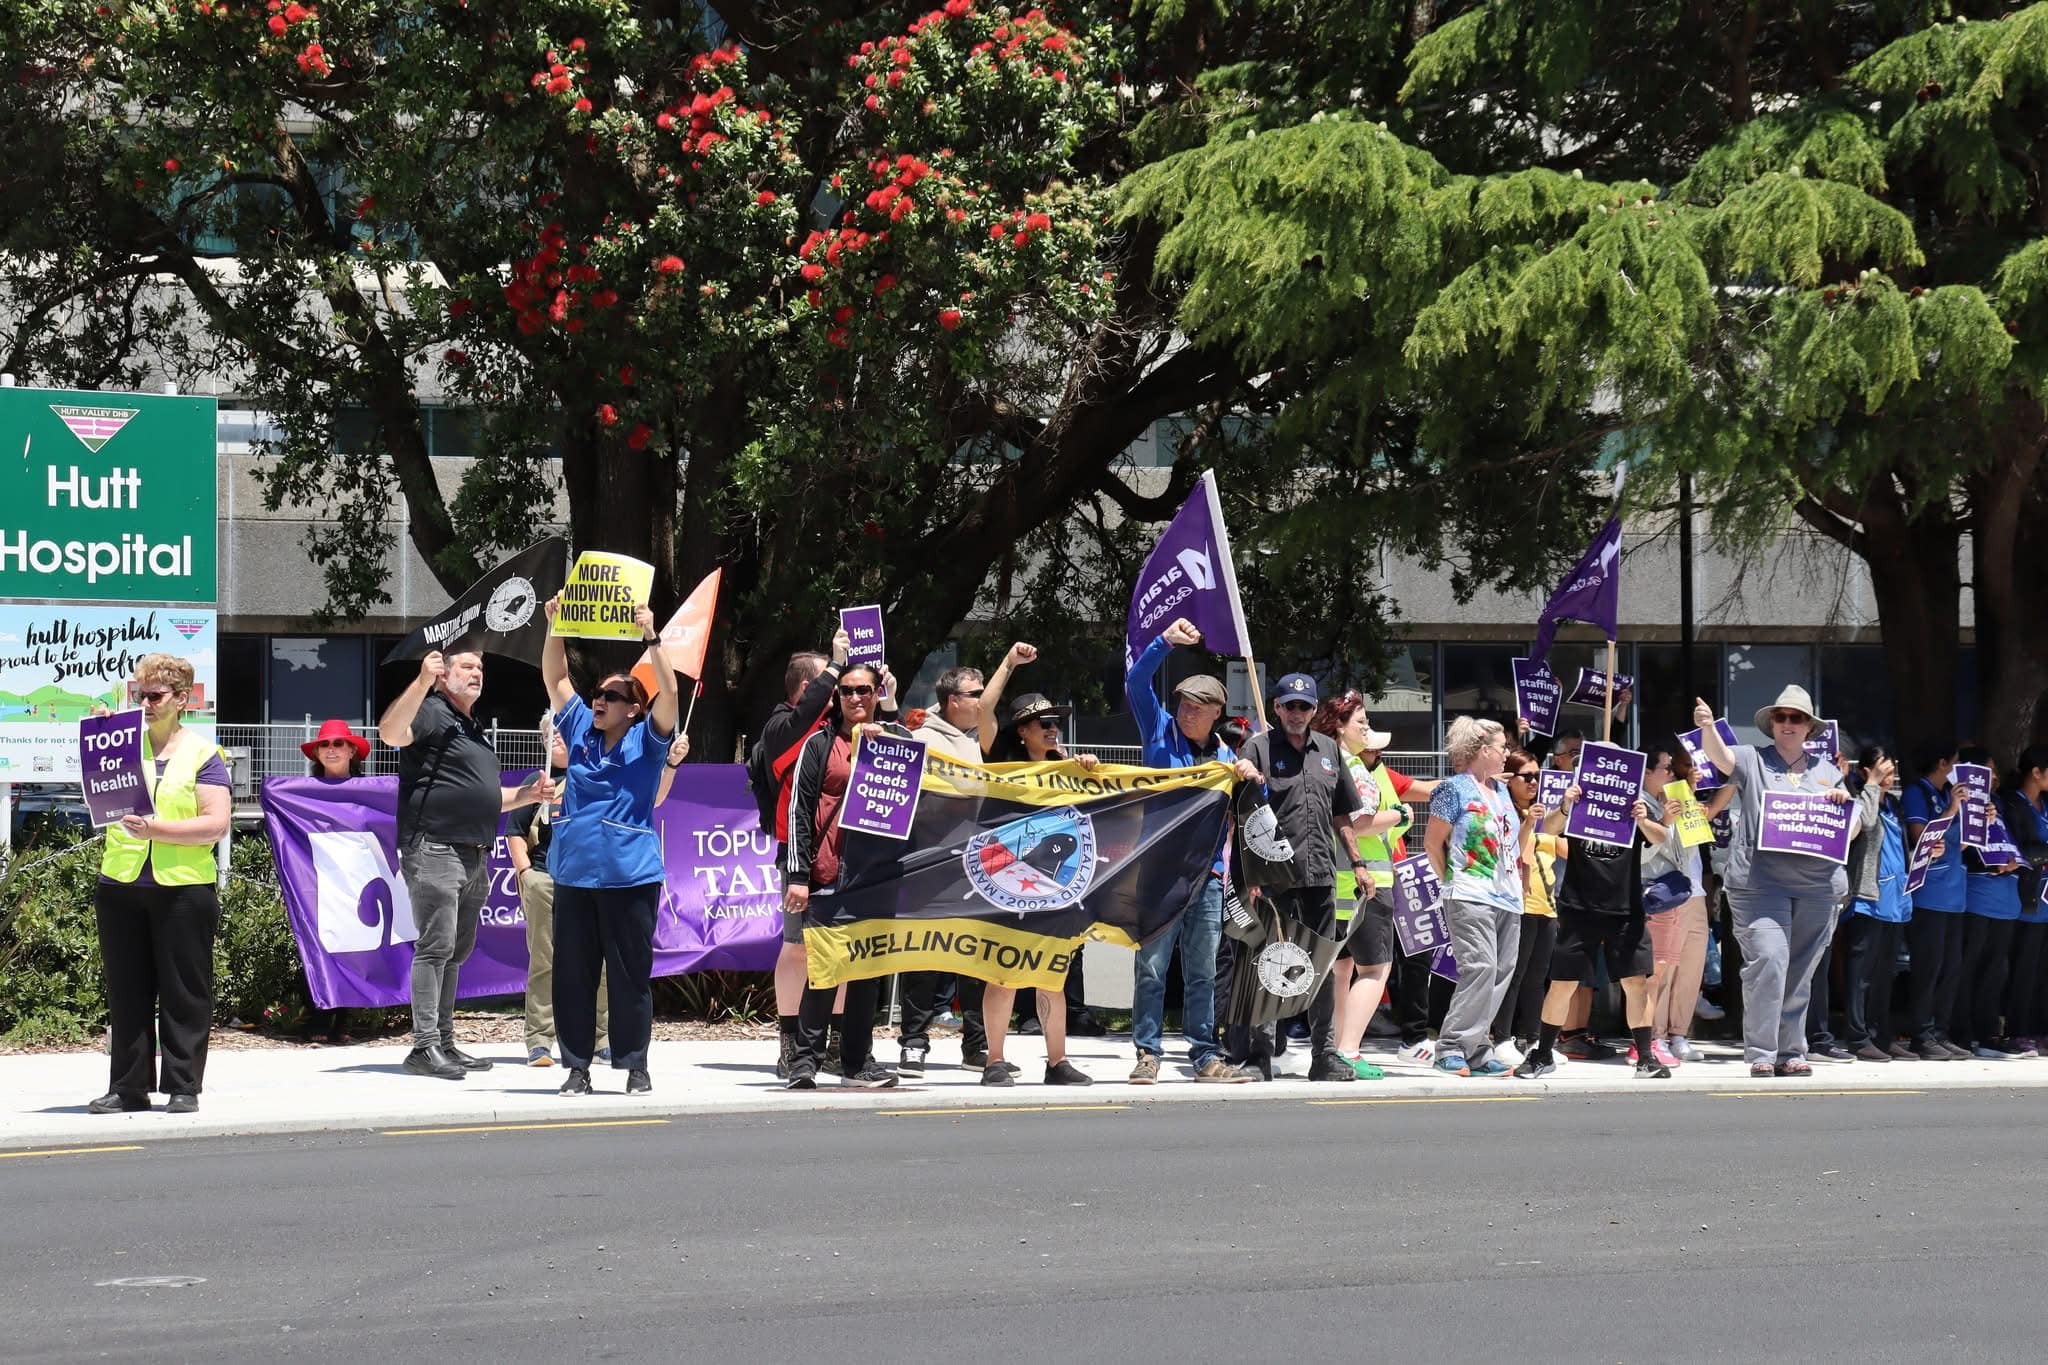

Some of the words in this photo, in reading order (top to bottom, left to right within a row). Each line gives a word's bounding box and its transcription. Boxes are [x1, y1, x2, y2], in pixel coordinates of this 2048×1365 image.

[61, 408, 80, 416] HUTT
[82, 409, 111, 417] VALLEY
[112, 410, 129, 418] DHB
[48, 465, 142, 509] Hutt
[0, 529, 192, 584] Hospital
[579, 564, 621, 582] MORE
[564, 584, 635, 604] MIDWIVES,
[561, 604, 596, 622] MORE
[27, 619, 69, 649] hutt
[853, 627, 874, 640] Here
[45, 647, 57, 664] to
[62, 645, 80, 661] be
[1520, 680, 1558, 695] staffing
[1588, 686, 1606, 696] live
[1527, 692, 1553, 703] saves
[1530, 702, 1549, 715] lives
[0, 736, 32, 745] Thanks
[35, 736, 48, 745] for
[50, 737, 67, 745] not
[84, 727, 137, 751] TOOT
[866, 740, 919, 763] Quality
[100, 756, 123, 772] for
[873, 757, 906, 773] Care
[1596, 757, 1628, 773] Safe
[90, 772, 138, 794] health
[864, 772, 908, 788] needs
[1543, 774, 1570, 789] Fair
[1582, 772, 1637, 795] staffing
[1968, 774, 1986, 787] Safe
[856, 783, 910, 806] Quality
[1542, 790, 1563, 805] for
[1587, 790, 1627, 806] saves
[866, 800, 894, 818] Pay
[1587, 803, 1621, 821] lives
[1771, 800, 1805, 810] Good
[1808, 801, 1845, 816] health
[1768, 811, 1806, 821] needs
[1808, 813, 1846, 829] valued
[1778, 822, 1836, 838] midwives
[1922, 829, 1946, 843] TOOT
[1061, 832, 1092, 901] ZEALAND
[1006, 897, 1048, 910] 2002
[1396, 864, 1423, 911] Rise
[1413, 914, 1434, 947] Up
[704, 904, 773, 920] KAITIAKI
[1226, 896, 1254, 929] UNION
[847, 931, 1043, 972] WELLINGTON
